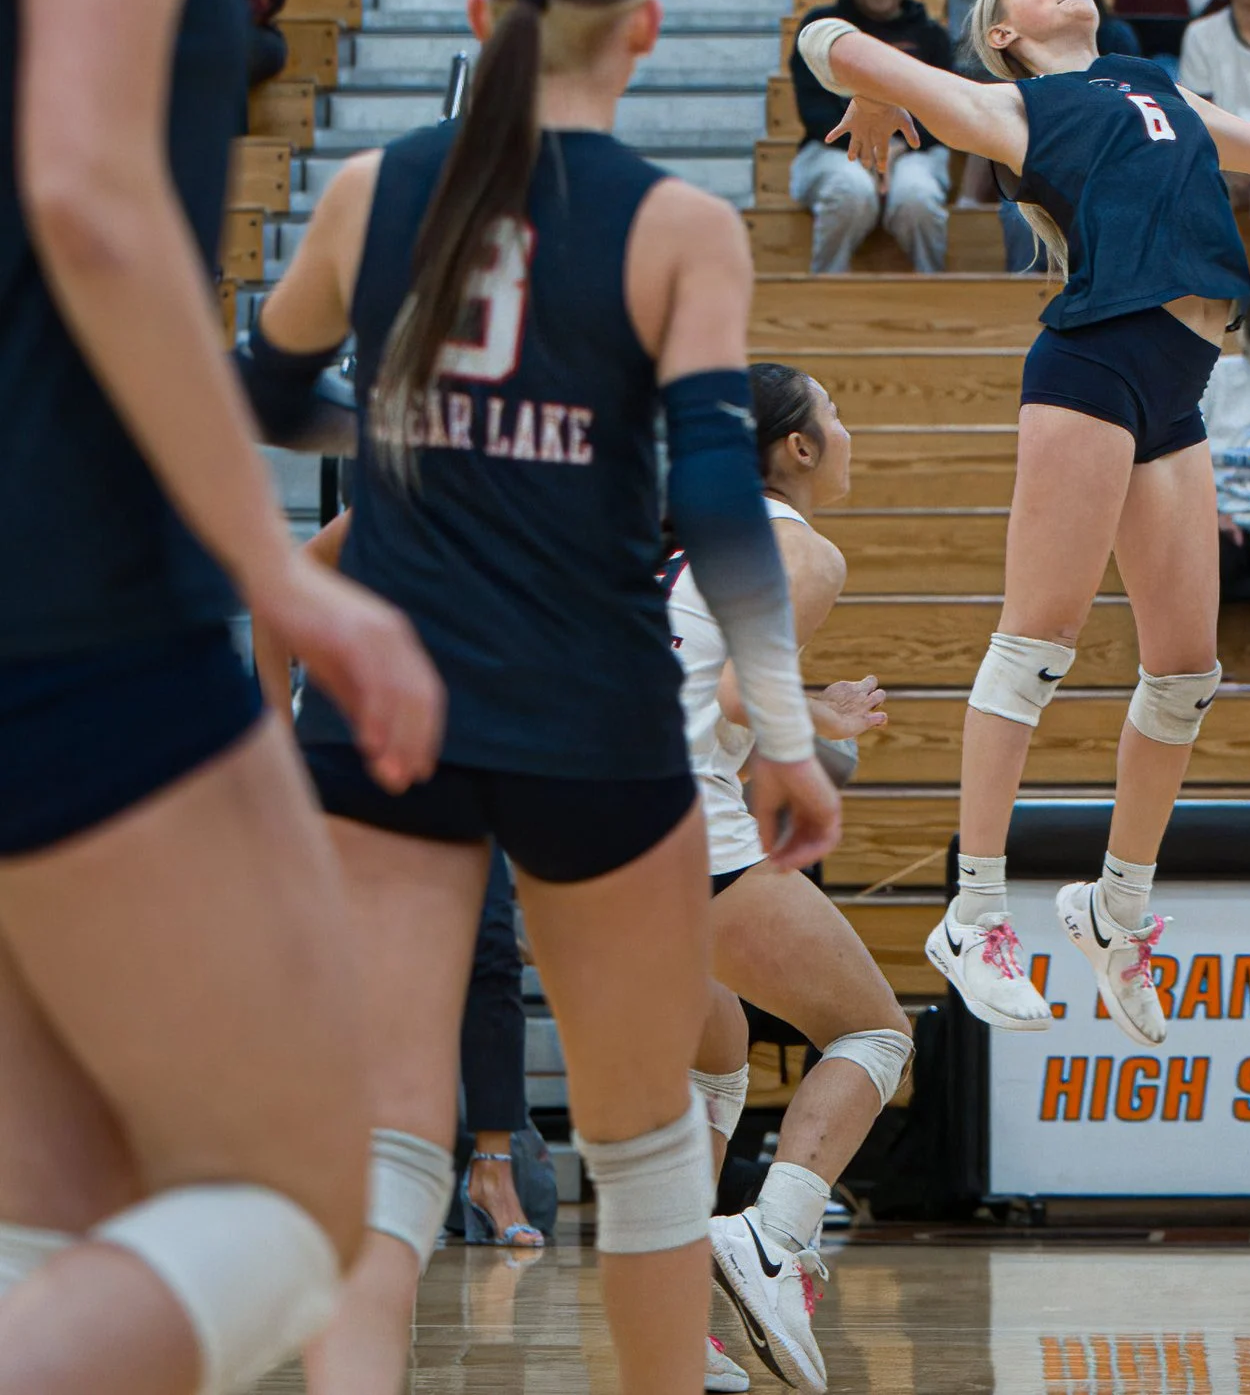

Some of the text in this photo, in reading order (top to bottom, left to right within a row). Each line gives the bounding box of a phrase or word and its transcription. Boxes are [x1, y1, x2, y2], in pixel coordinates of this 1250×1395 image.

[1125, 93, 1176, 142] 6
[434, 212, 538, 384] 3
[368, 388, 595, 466] EAR LAKE
[1039, 1056, 1210, 1122] HIGH
